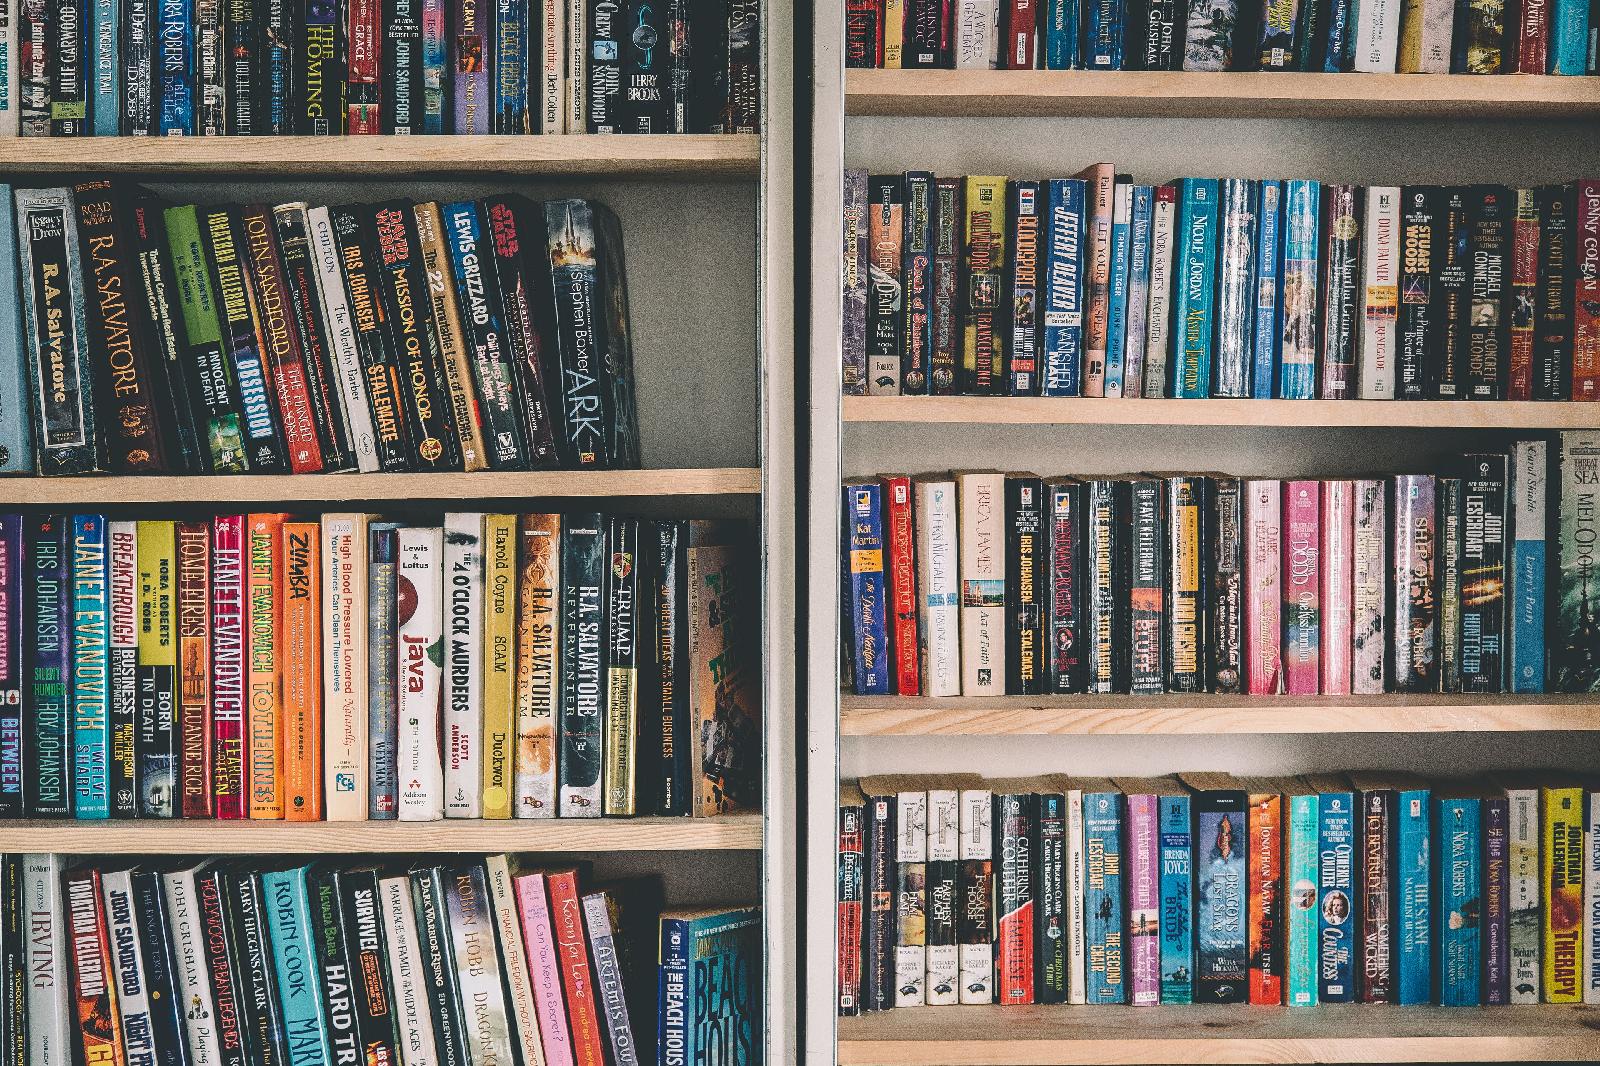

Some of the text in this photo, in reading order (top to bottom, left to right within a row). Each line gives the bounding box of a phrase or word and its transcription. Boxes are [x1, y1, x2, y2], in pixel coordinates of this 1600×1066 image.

[132, 13, 146, 44] DEATH
[321, 26, 334, 58] THE
[355, 25, 365, 61] GRACE
[595, 2, 619, 38] CREW
[962, 3, 974, 63] GENTLEMAN
[1148, 10, 1161, 64] GRISHAM
[1160, 21, 1174, 53] JOHN
[1333, 22, 1344, 53] Over Me
[60, 7, 76, 94] JULIE GARWOOD
[99, 21, 112, 94] VENGEANCE TRAIL
[307, 27, 322, 117] HOMING
[605, 65, 619, 95] JOHN
[396, 40, 409, 123] JOHN SANDFORD
[592, 65, 605, 123] SANDFORD
[1099, 176, 1109, 208] Palmer
[317, 221, 336, 274] CHILTON
[453, 211, 489, 325] LEWIS GRIZZARD
[971, 211, 992, 271] SALVATORE
[1015, 217, 1036, 286] BLOODSPORT
[1053, 207, 1078, 309] JEFFERY DEAVER
[1190, 215, 1207, 301] NICOLE JORDAN
[1405, 225, 1418, 274] WOODS
[1418, 225, 1430, 274] STUART
[245, 215, 289, 355] JOHN SANDFORD
[343, 245, 376, 332] IRIS JOHANSEN
[1473, 251, 1487, 297] CONNELLY
[1488, 255, 1502, 294] MICHAEL
[42, 263, 66, 402] R.A. Salvatore
[393, 268, 432, 423] MISSION OF HONOR
[570, 272, 591, 374] Stephen Baxter
[1376, 326, 1385, 371] RENEGADE
[197, 356, 215, 406] IN DEATH
[209, 350, 229, 405] INNOCENT
[1048, 351, 1057, 388] MAN
[1057, 326, 1072, 388] VANISHED
[1403, 332, 1416, 383] Beverly Hills
[235, 358, 273, 439] OBSESSION
[288, 367, 313, 443] THE HANGED
[368, 363, 398, 443] STALEMATE
[565, 370, 600, 441] ARK
[331, 535, 340, 558] Your
[1139, 501, 1154, 581] FAYE KELLERMAN
[1465, 495, 1483, 560] LESCROART
[1483, 513, 1502, 543] JOHN
[112, 532, 134, 645] BREAKTHROUGH
[180, 531, 207, 636] HOME FIRES
[332, 560, 340, 591] Arteries
[1020, 536, 1032, 602] IRIS JOHANSEN
[1291, 540, 1308, 584] DODD
[36, 540, 59, 651] IRIS JOHANSEN
[159, 559, 169, 646] NORA ROBERTS
[252, 530, 272, 672] JANET EVANOVICH
[332, 594, 340, 610] Can
[342, 535, 354, 693] High Blood Pressure Lowered
[493, 528, 508, 672] Harold Coyne SCAM
[617, 586, 632, 656] TRUMP
[74, 536, 105, 730] JANET EVANOVICH
[213, 548, 242, 722] JANET EVANOVICH
[452, 553, 471, 711] THE 4 O'CLOCK MURDERS
[531, 588, 552, 718] R.A. SALVATORE
[578, 586, 599, 716] R.A. SALVATORE
[1021, 629, 1032, 680] STALEMATE
[1135, 619, 1148, 672] BLUFF
[1481, 634, 1498, 654] THE
[112, 649, 122, 714] DEVELOPMENT
[122, 649, 135, 715] BUSINESS
[333, 641, 341, 692] Themselves
[142, 678, 154, 743] IN DEATH
[158, 691, 170, 730] BORN
[1, 718, 19, 793] BETWEEN
[38, 703, 59, 802] ROY JOHANSEN
[76, 745, 89, 797] SHARP
[91, 742, 104, 800] TWELVE
[114, 732, 123, 761] MILLER
[123, 723, 134, 778] MACPHERSON
[185, 707, 202, 795] LUANNE RICE
[451, 724, 459, 770] ANDERSON
[460, 734, 469, 760] SCOTT
[1002, 836, 1016, 904] COULTER
[1017, 837, 1029, 901] CATHERINE
[1088, 838, 1103, 890] LESCROART
[1103, 852, 1119, 875] JOHN
[1260, 826, 1272, 876] JONATHAN
[1552, 822, 1565, 888] KELLERMAN
[1567, 825, 1581, 885] JONATHAN
[354, 890, 378, 951] SURVIVE!
[933, 886, 943, 920] REACH
[942, 879, 952, 927] FARTHEST
[967, 885, 976, 920] HOUSE
[975, 874, 987, 929] FORSAKEN
[1225, 872, 1238, 932] DRAGONS
[31, 910, 54, 990] IRVING
[69, 879, 104, 997] JONATHAN KELLERMAN
[172, 879, 197, 987] JOHN GRISHAM
[273, 881, 307, 998] ROBIN COOK
[1090, 945, 1105, 972] CHAIR
[1106, 932, 1120, 984] THE SECOND
[109, 890, 153, 1050] JOHN SANDFORD NIGHT
[1554, 931, 1578, 996] THERAPY
[325, 964, 351, 1030] HARD
[473, 992, 494, 1050] DRAGON
[666, 983, 683, 1028] BEACH
[197, 1027, 210, 1064] Playing
